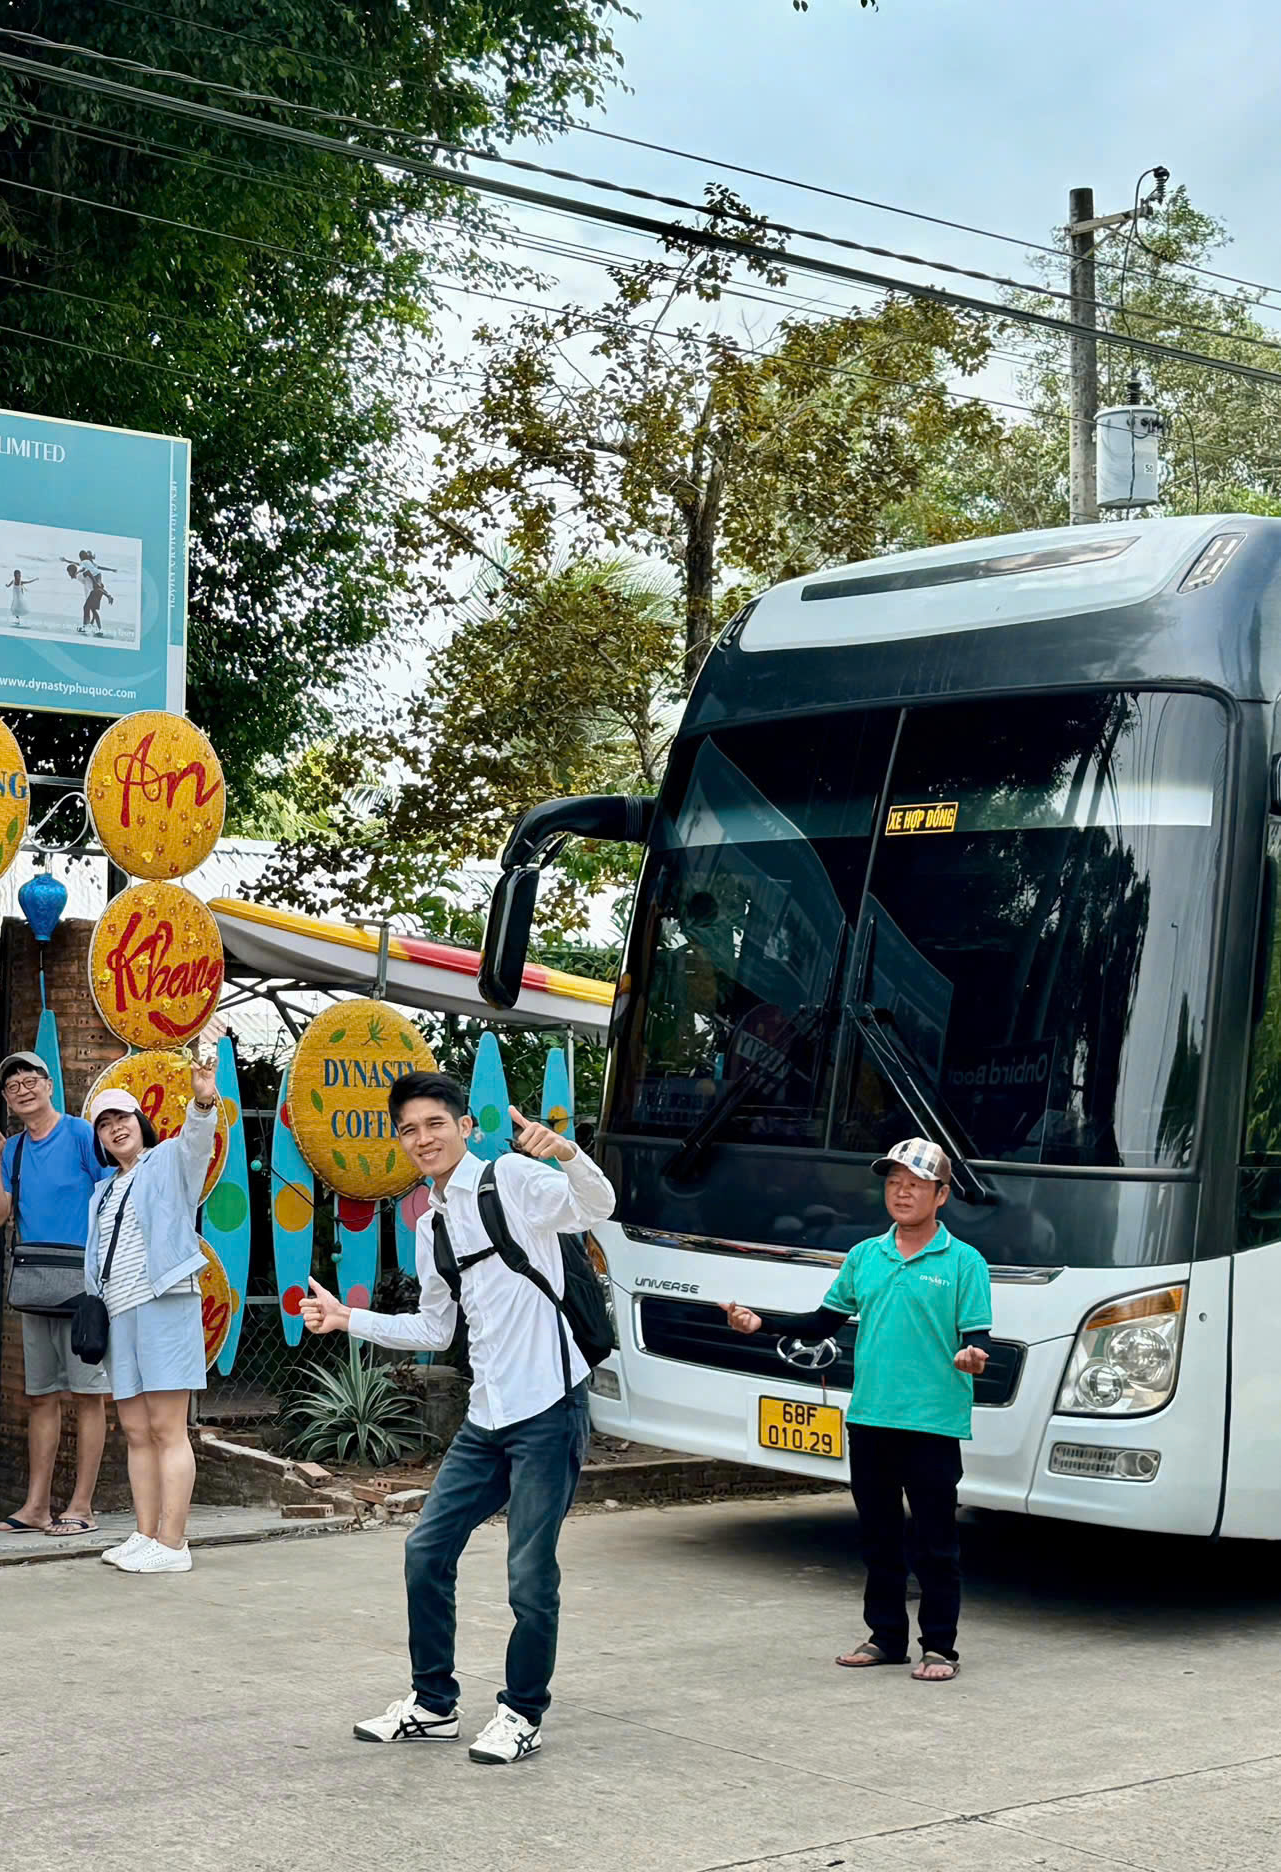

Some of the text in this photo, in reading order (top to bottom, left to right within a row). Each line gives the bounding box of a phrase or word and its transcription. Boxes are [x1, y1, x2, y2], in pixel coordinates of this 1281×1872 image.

[0, 677, 137, 699] www.dynastyphuquoc.com
[114, 730, 221, 828] An
[888, 811, 904, 831] XE
[106, 911, 224, 1037] Khang
[331, 1109, 399, 1139] COFF
[634, 1276, 701, 1294] UNIVERSE
[783, 1403, 817, 1426] 68F
[769, 1424, 832, 1454] 010.29
